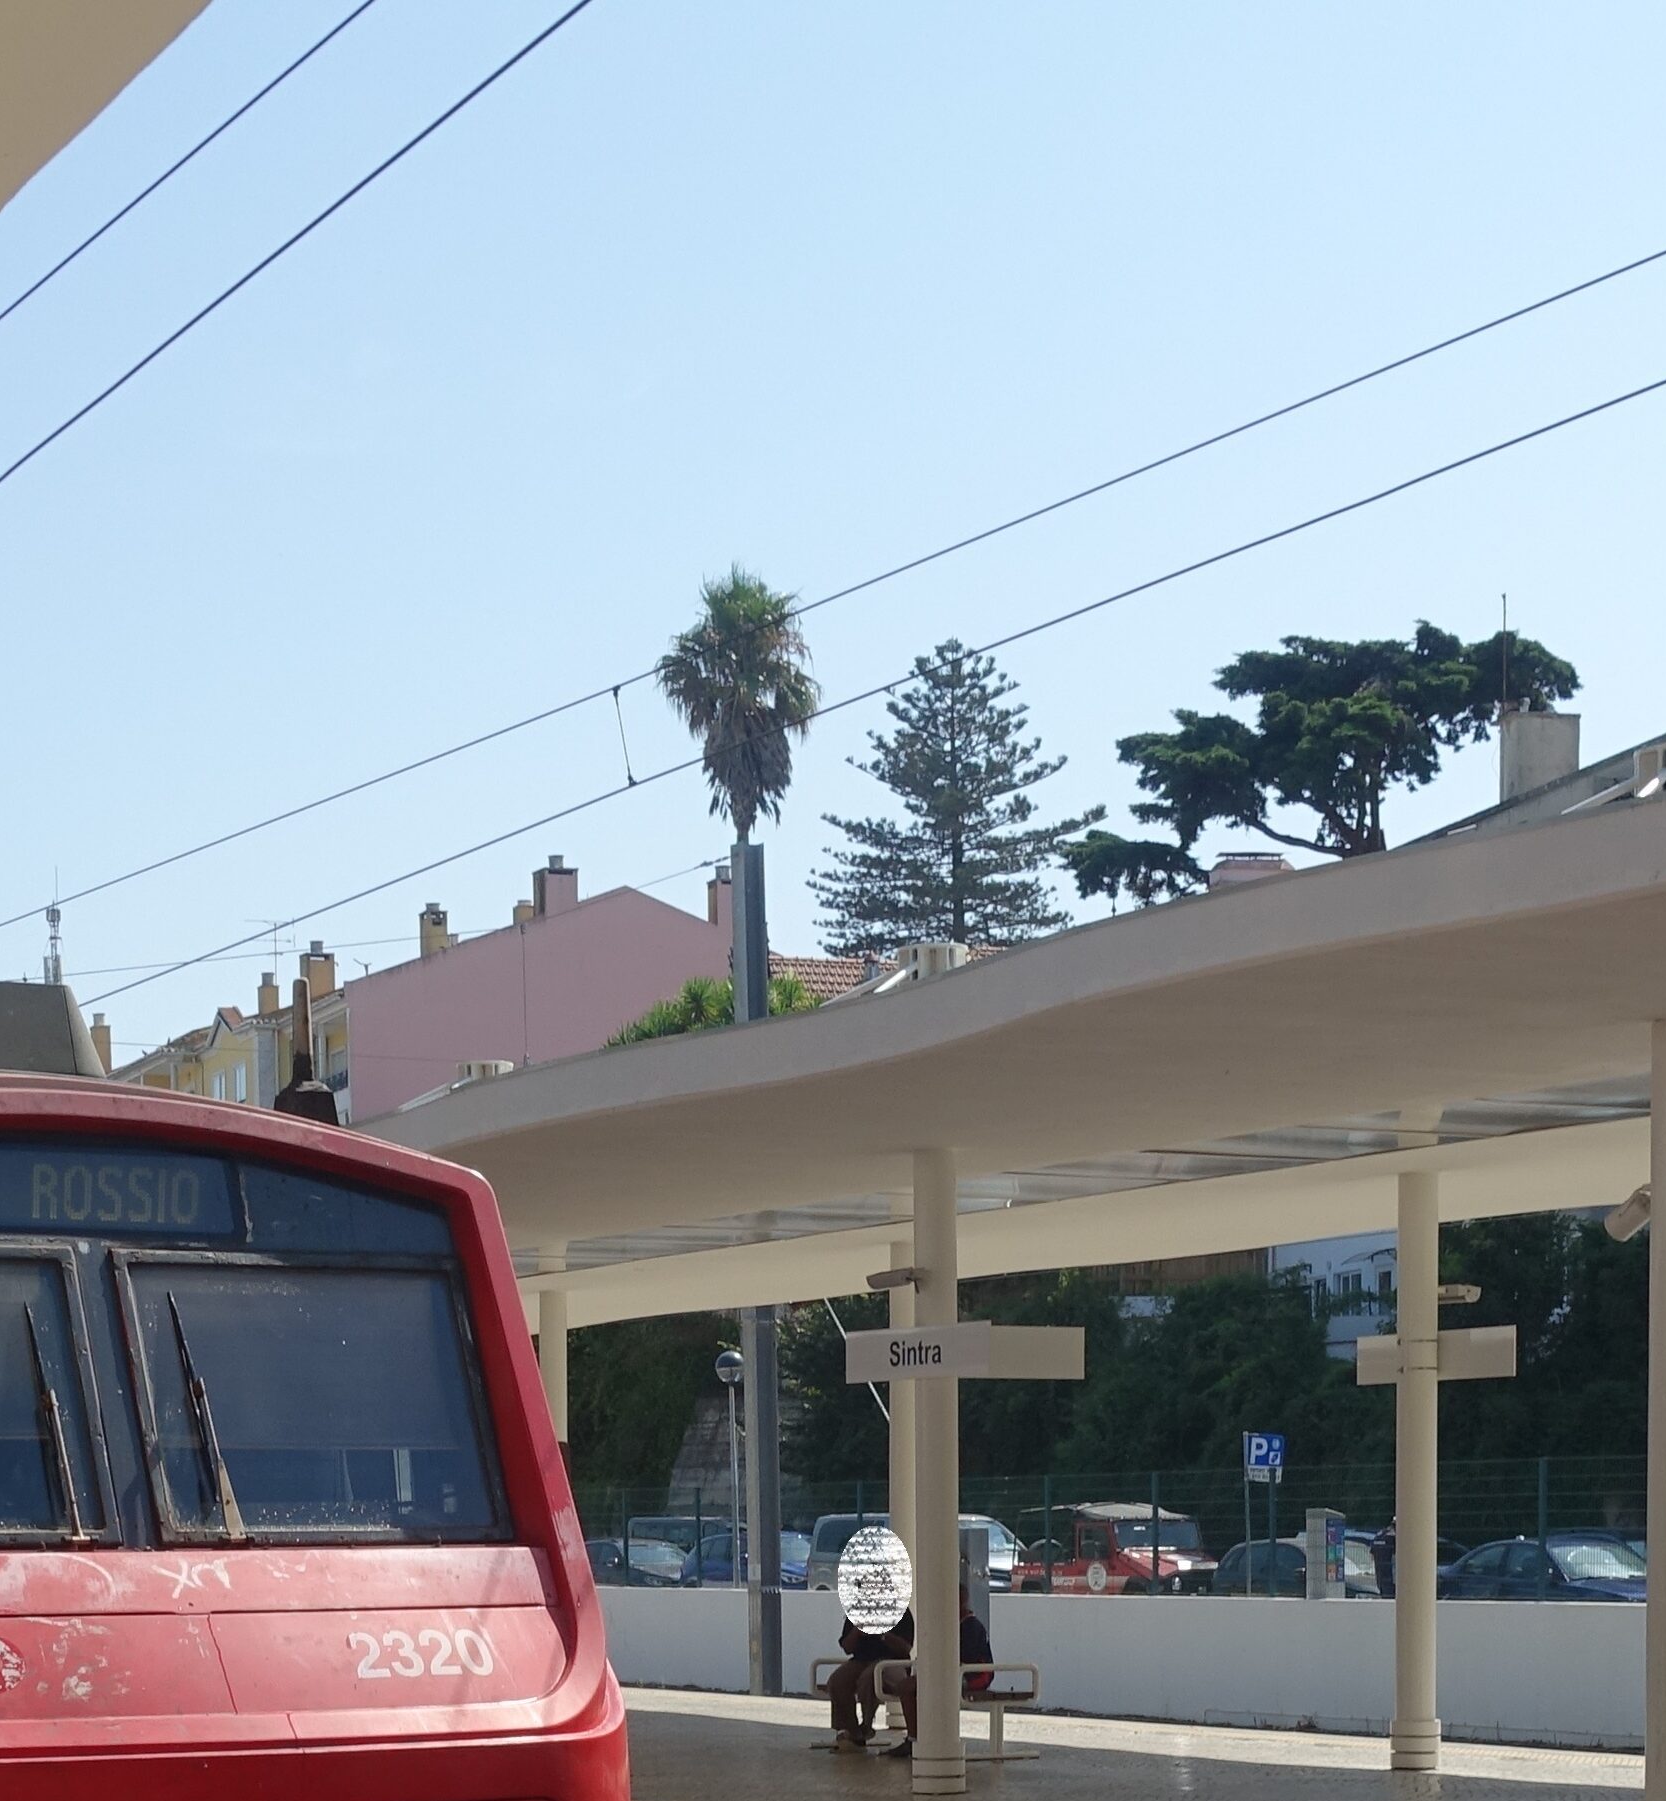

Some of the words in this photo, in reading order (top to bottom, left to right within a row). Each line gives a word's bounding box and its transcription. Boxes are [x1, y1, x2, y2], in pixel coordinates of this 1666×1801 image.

[31, 1163, 201, 1225] ROSSIO
[889, 1340, 943, 1368] Sintra
[1249, 1436, 1269, 1465] P
[348, 1627, 495, 1679] 2320
